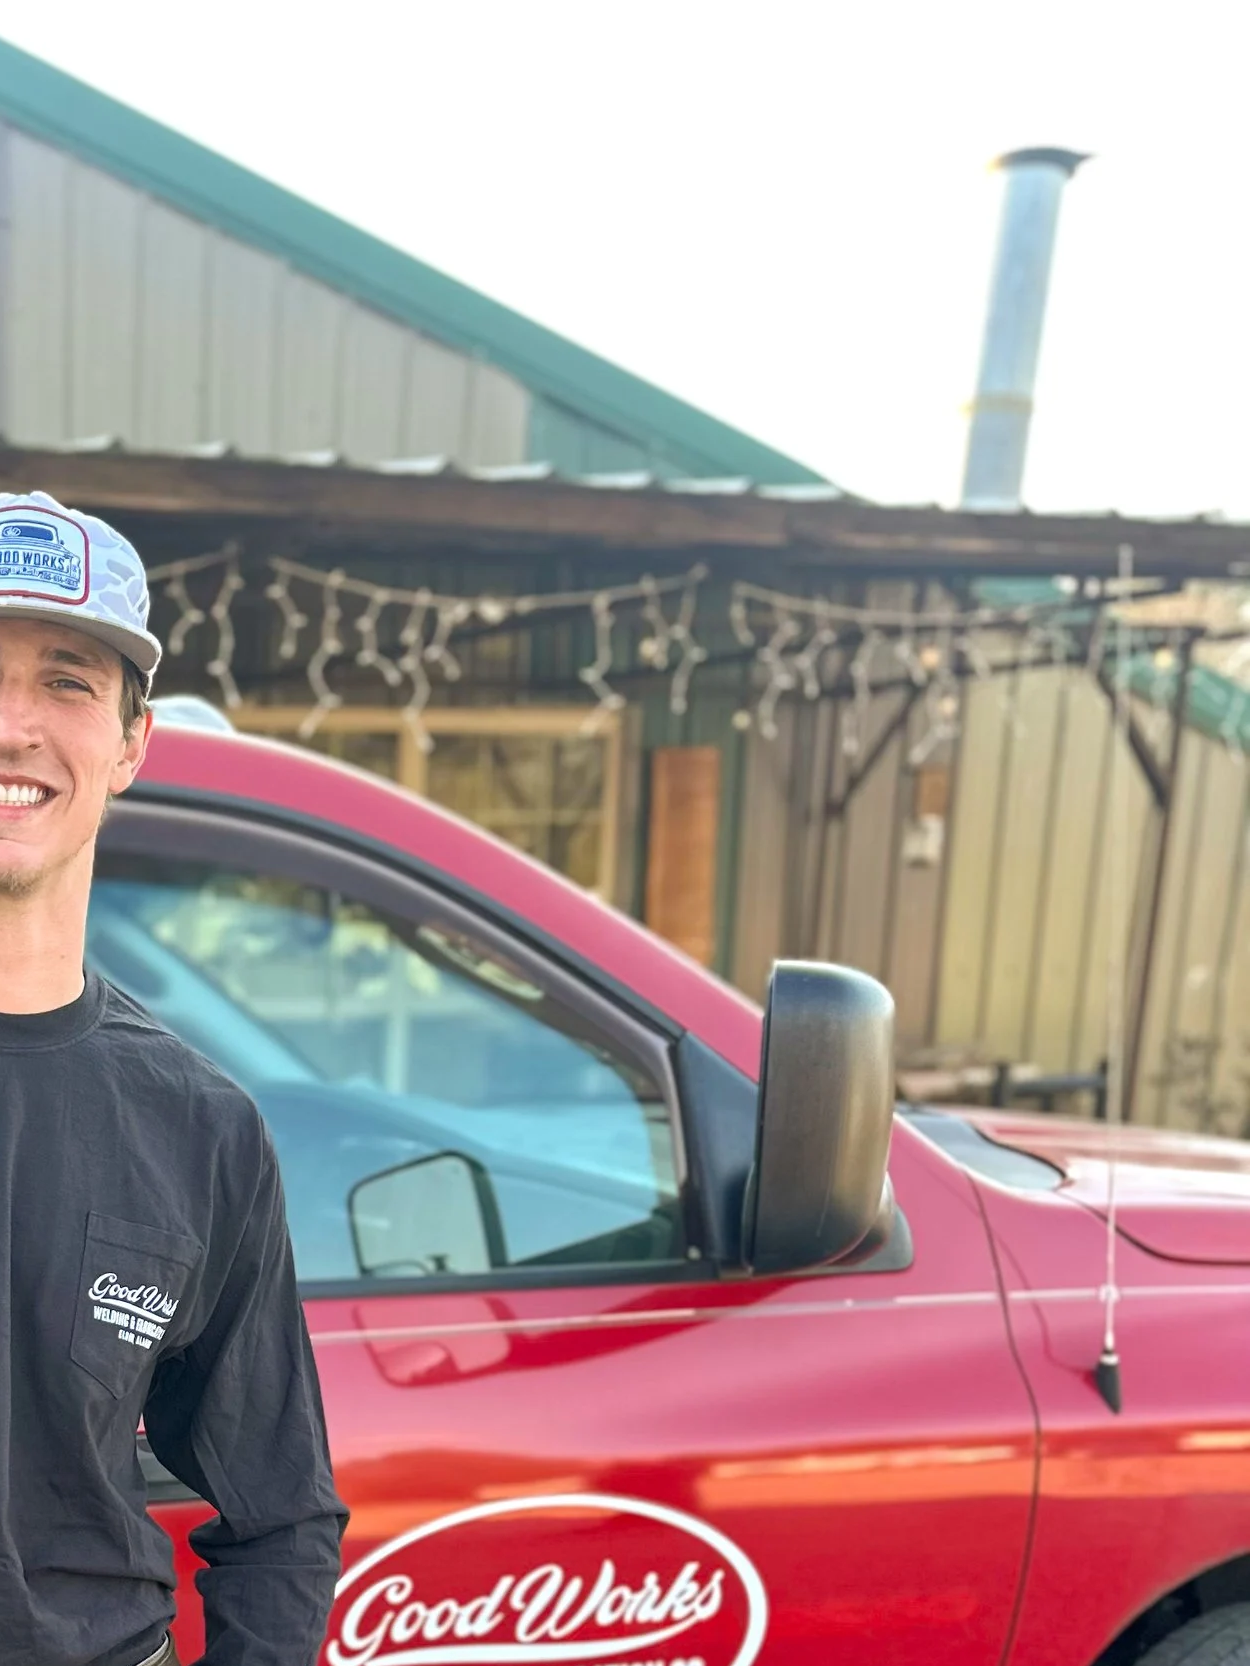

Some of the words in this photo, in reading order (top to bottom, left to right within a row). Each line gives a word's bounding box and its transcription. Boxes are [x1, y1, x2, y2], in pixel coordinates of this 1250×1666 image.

[22, 551, 65, 571] WORKS
[88, 1272, 146, 1301] Good
[93, 1305, 130, 1328] WELDING
[510, 1559, 725, 1643] Works
